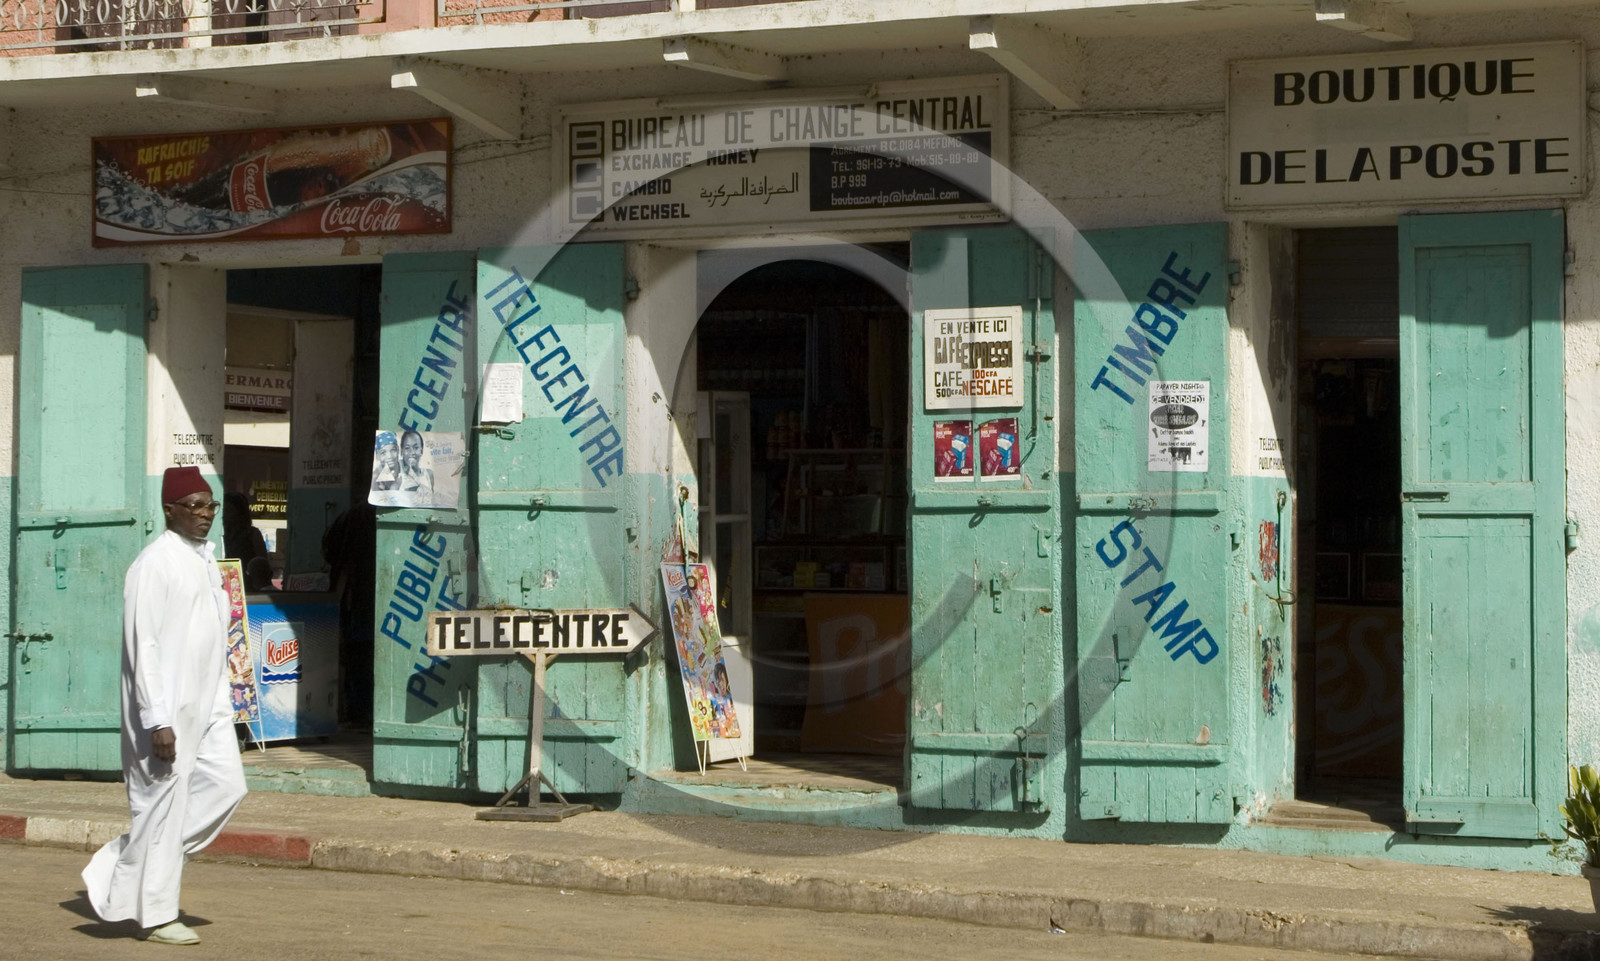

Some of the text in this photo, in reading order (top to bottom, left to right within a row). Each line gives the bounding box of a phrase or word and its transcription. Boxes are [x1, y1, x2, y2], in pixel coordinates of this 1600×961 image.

[1273, 57, 1536, 106] BOUTIQUE
[612, 95, 992, 152] BUREAU DE CHANGE CENTRAL
[147, 160, 196, 184] TA SOIF
[612, 148, 760, 172] EXCHANGE MONEY
[1239, 137, 1570, 185] DE LA POSTE
[612, 178, 672, 197] CAMBIO
[849, 174, 867, 187] 999
[320, 194, 406, 234] Coca-Cola
[612, 203, 691, 221] WECHSEL
[941, 320, 1007, 335] EN VENTE ICI
[1090, 250, 1212, 406] TIMBRE
[398, 279, 472, 433] ECENTRE
[934, 334, 963, 364] CAFÉ
[484, 265, 624, 488] TELECENTRE
[934, 371, 963, 388] CAFE
[229, 394, 283, 407] BIENVENUE
[173, 433, 214, 446] TELECENTRE
[174, 453, 195, 465] PUBLIC
[380, 524, 447, 650] PUBLIC
[1095, 520, 1220, 665] STAMP
[435, 613, 630, 650] TELECENTRE
[266, 639, 300, 666] Kalise
